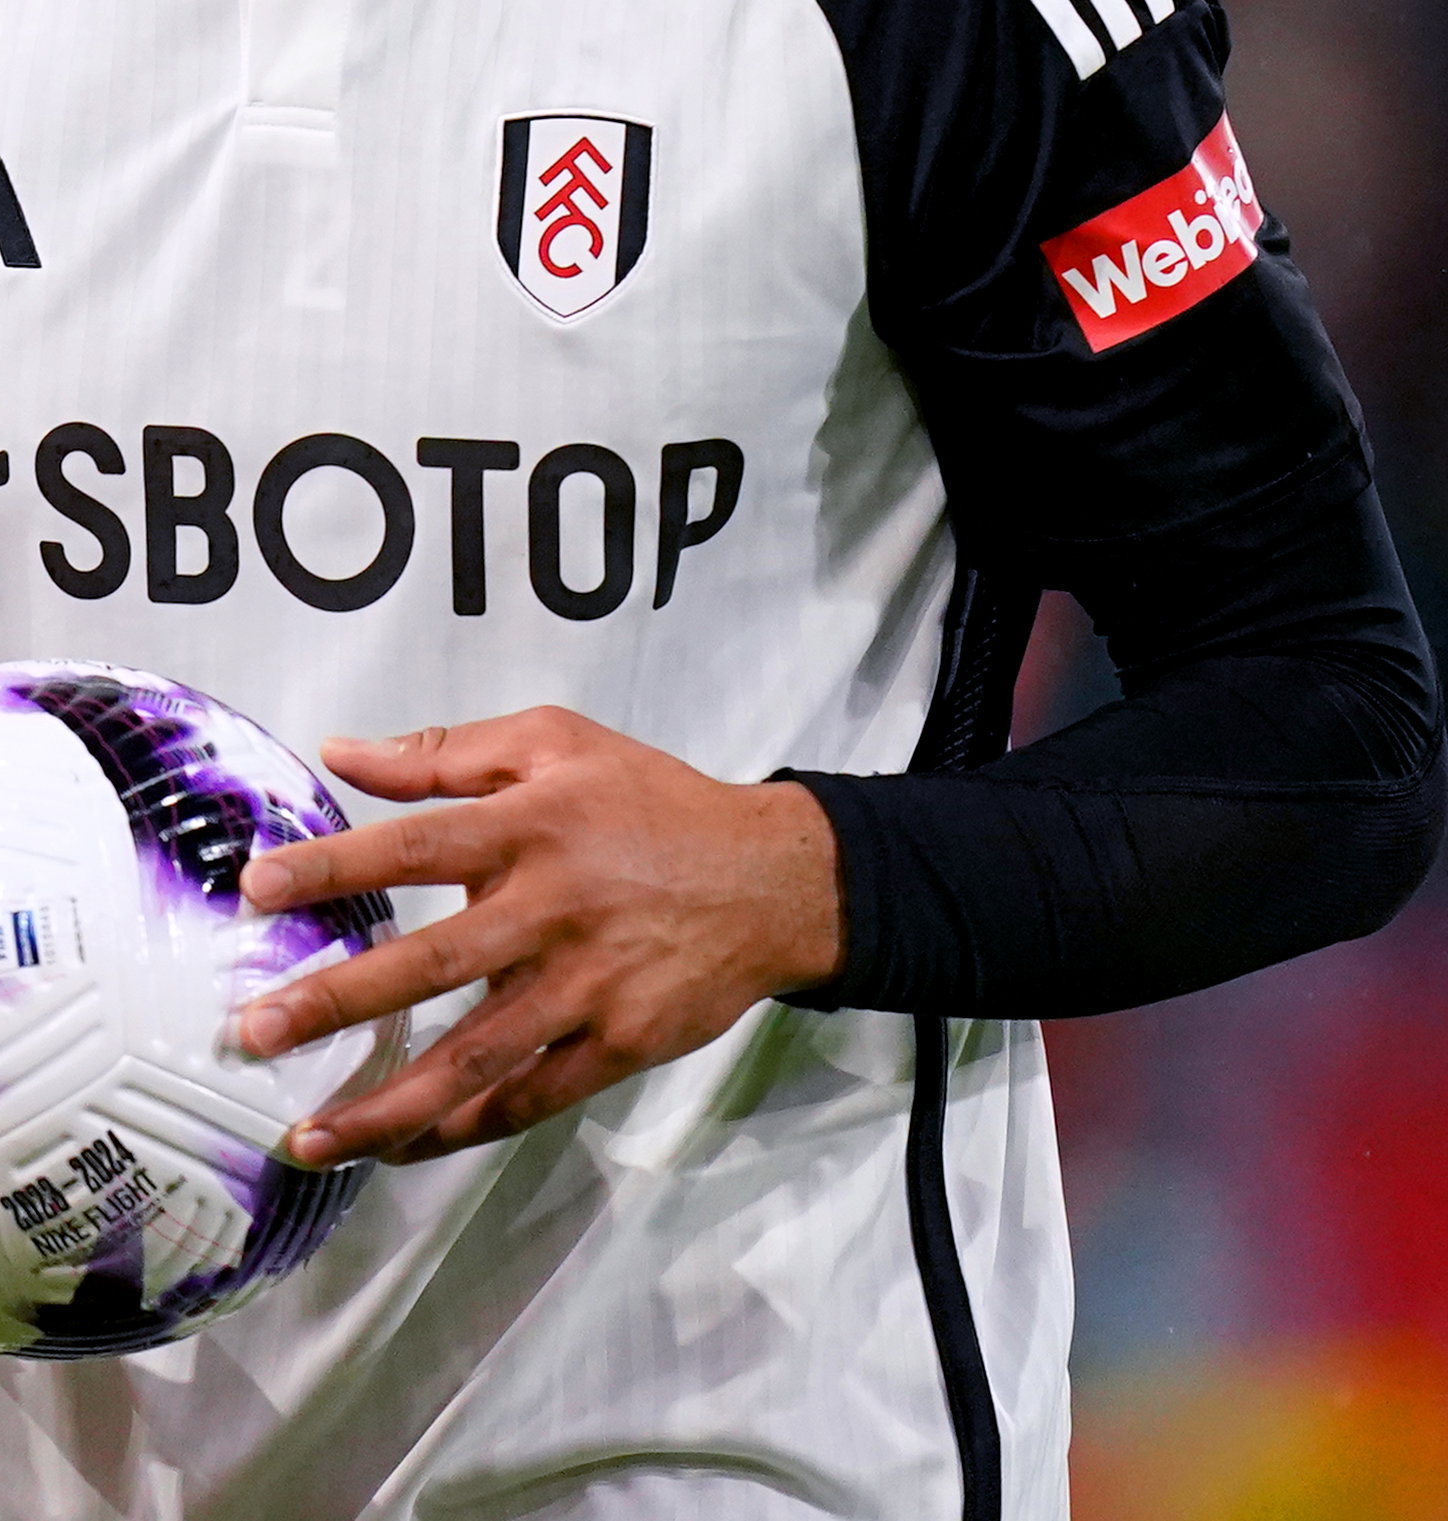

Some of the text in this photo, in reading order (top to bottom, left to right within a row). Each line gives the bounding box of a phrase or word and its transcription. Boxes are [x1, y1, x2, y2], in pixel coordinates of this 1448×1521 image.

[534, 136, 613, 279] FFC
[35, 422, 745, 621] SBOTOP
[31, 1217, 91, 1258] NIKE
[84, 1167, 158, 1231] FLIGHT
